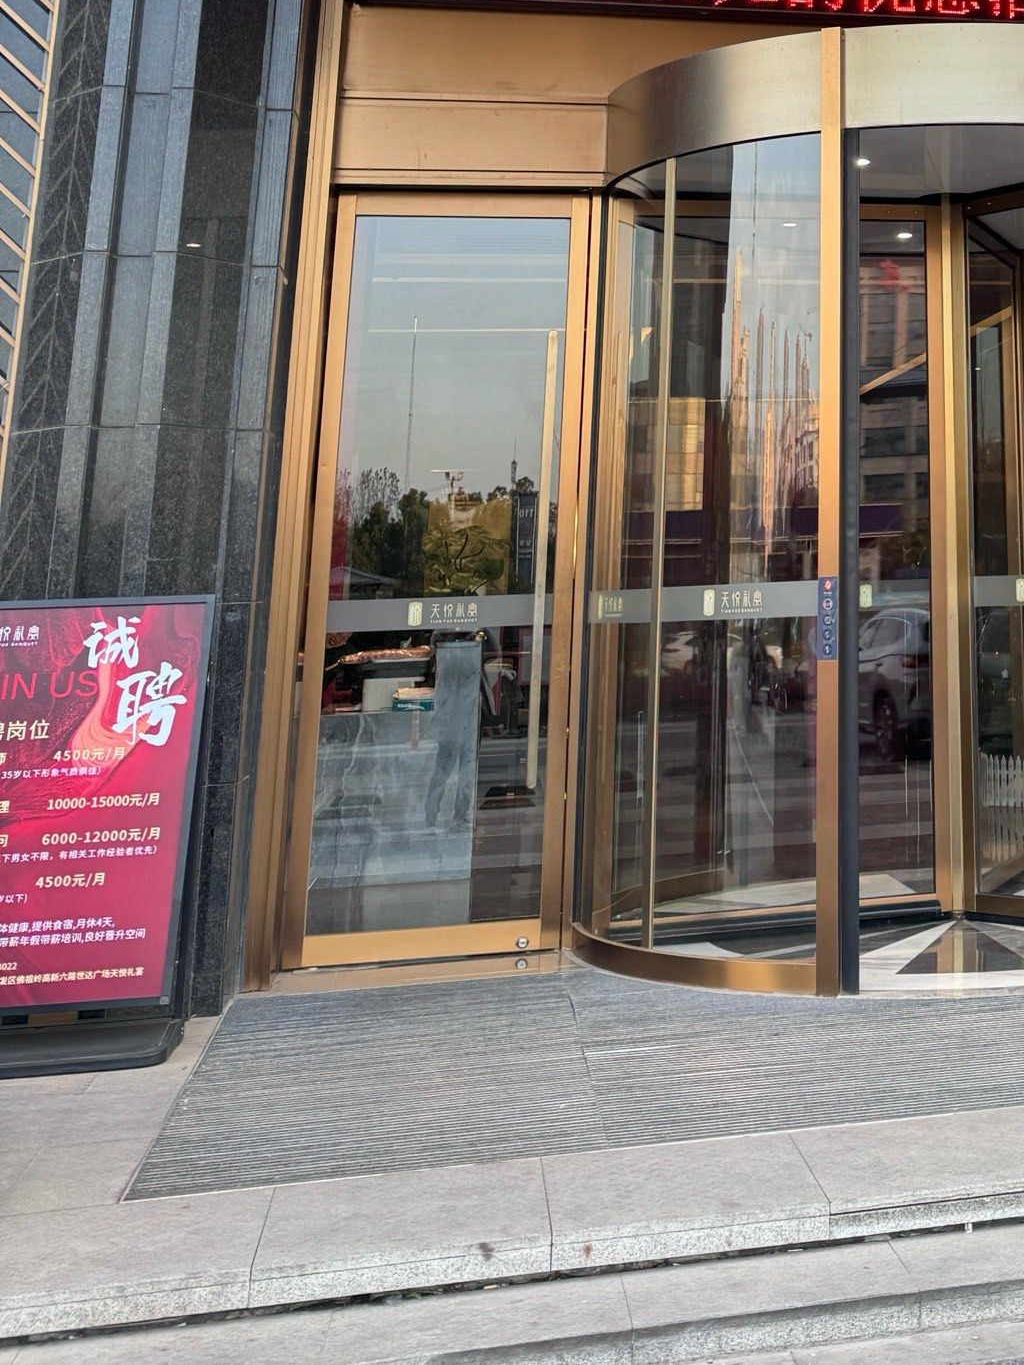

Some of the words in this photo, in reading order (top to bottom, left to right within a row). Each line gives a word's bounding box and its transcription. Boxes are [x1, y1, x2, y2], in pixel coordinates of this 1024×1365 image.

[50, 670, 99, 699] US
[53, 747, 125, 762] 4500元/月
[46, 792, 160, 810] 10000-15000元/月
[41, 827, 161, 846] 6000-12000元/月
[35, 872, 105, 888] 4500元/月
